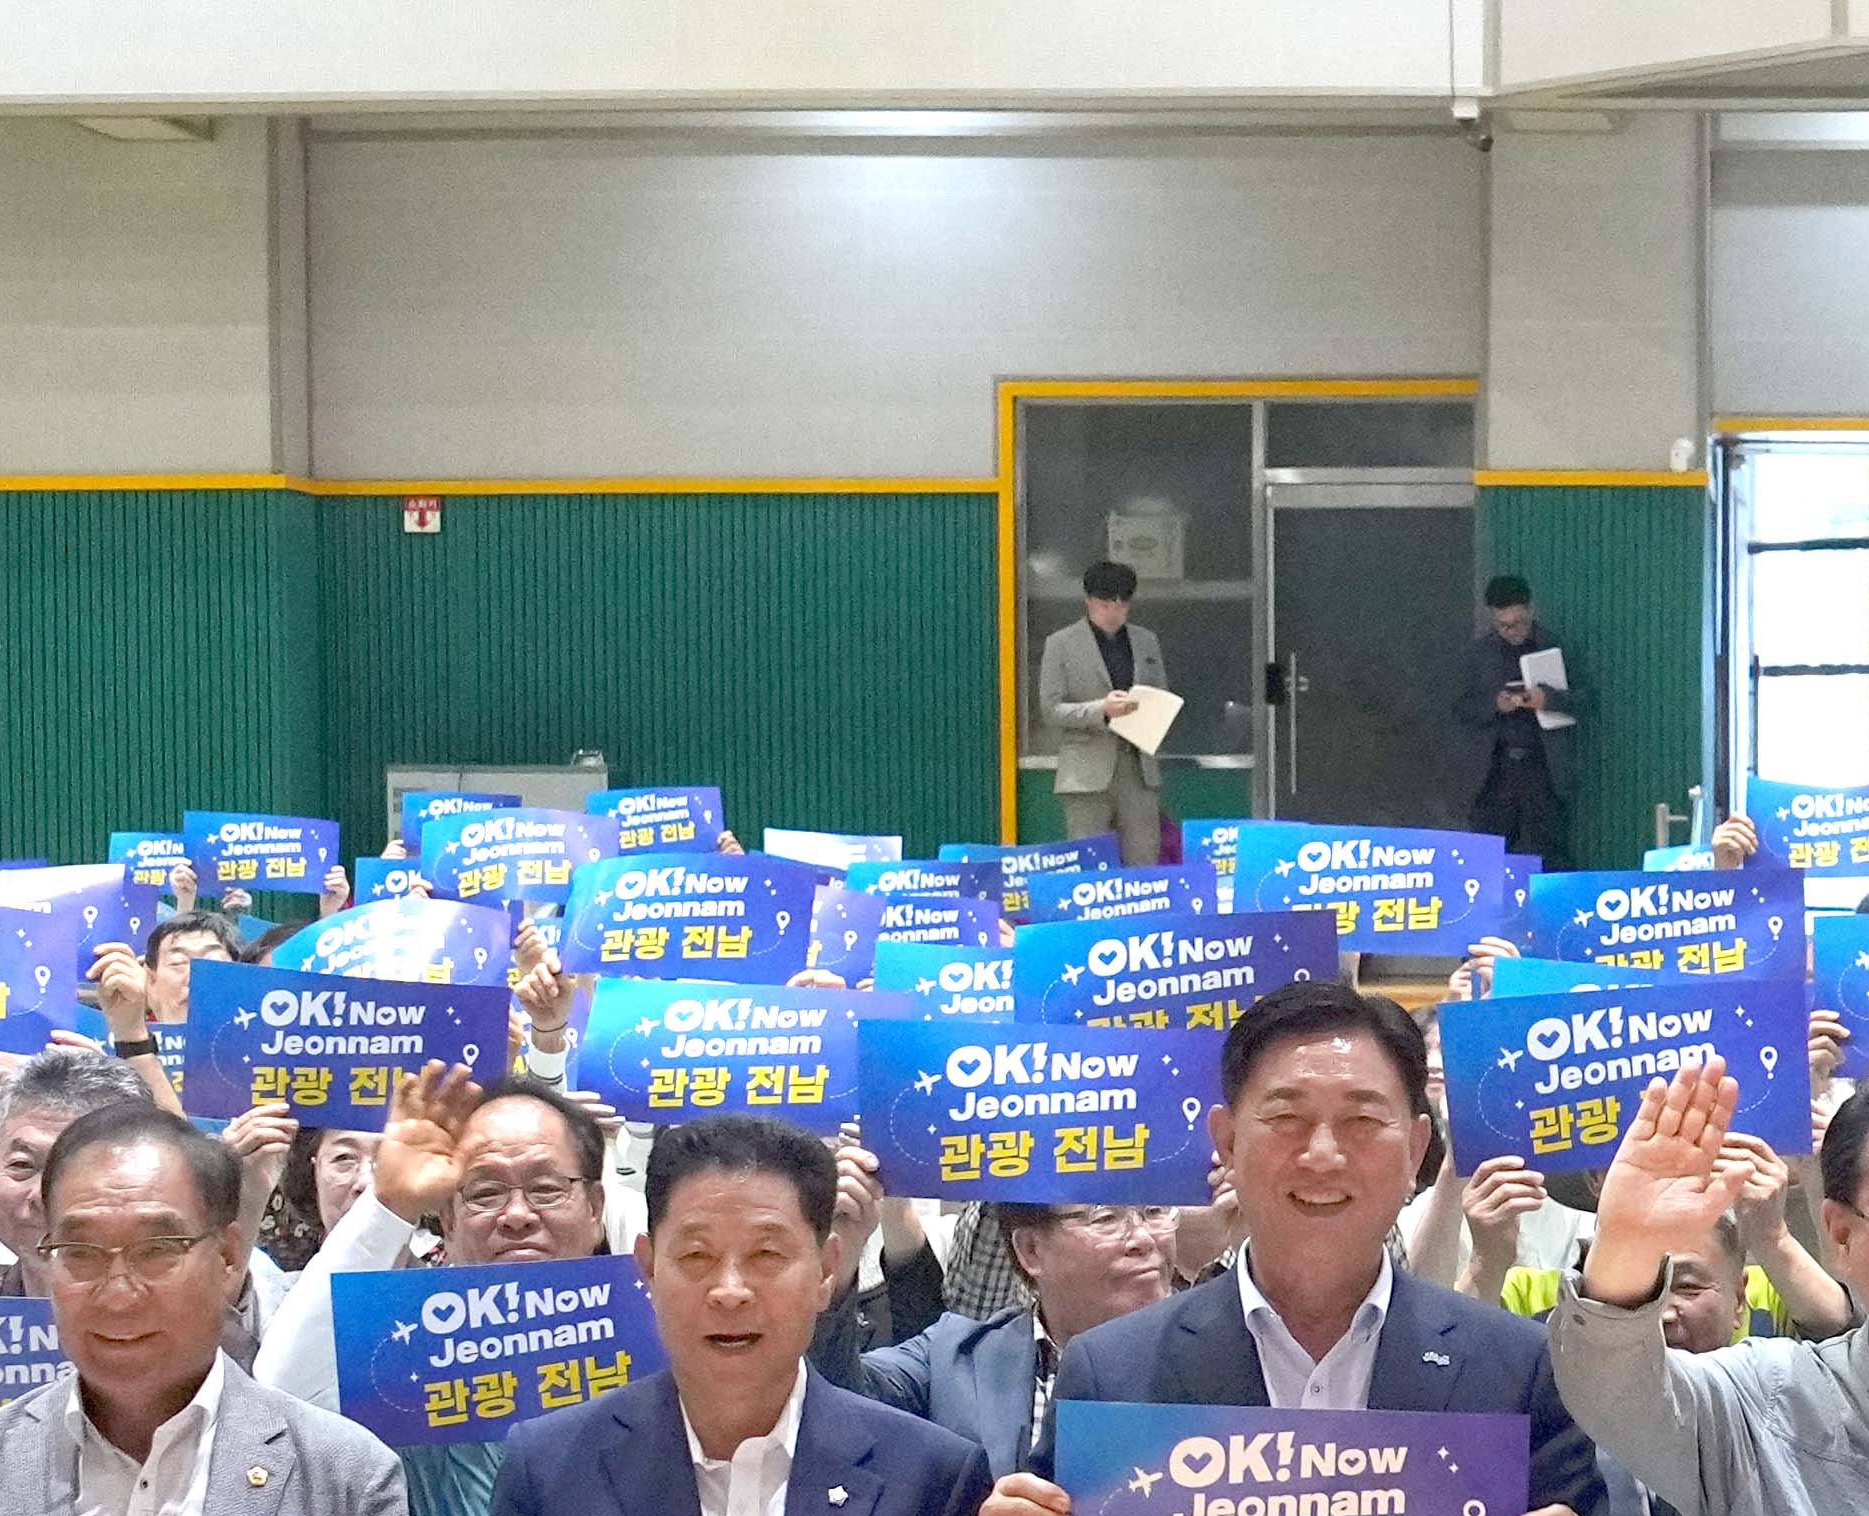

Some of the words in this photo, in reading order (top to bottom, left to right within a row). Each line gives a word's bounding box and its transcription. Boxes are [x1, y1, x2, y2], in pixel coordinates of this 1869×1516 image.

[1792, 793, 1844, 819] OK!
[220, 822, 264, 842] OK!
[265, 827, 302, 839] Now
[222, 843, 301, 856] Jeonnam
[1789, 842, 1840, 868] 관광
[218, 860, 257, 880] 관광
[267, 858, 306, 877] 전남
[615, 867, 685, 900] OK!
[685, 874, 748, 893] Now
[613, 901, 744, 921] Jeonnam
[601, 927, 669, 961] 관광
[682, 926, 752, 958] 전남
[1170, 1432, 1295, 1488] OK!
[1301, 1443, 1407, 1478] Now
